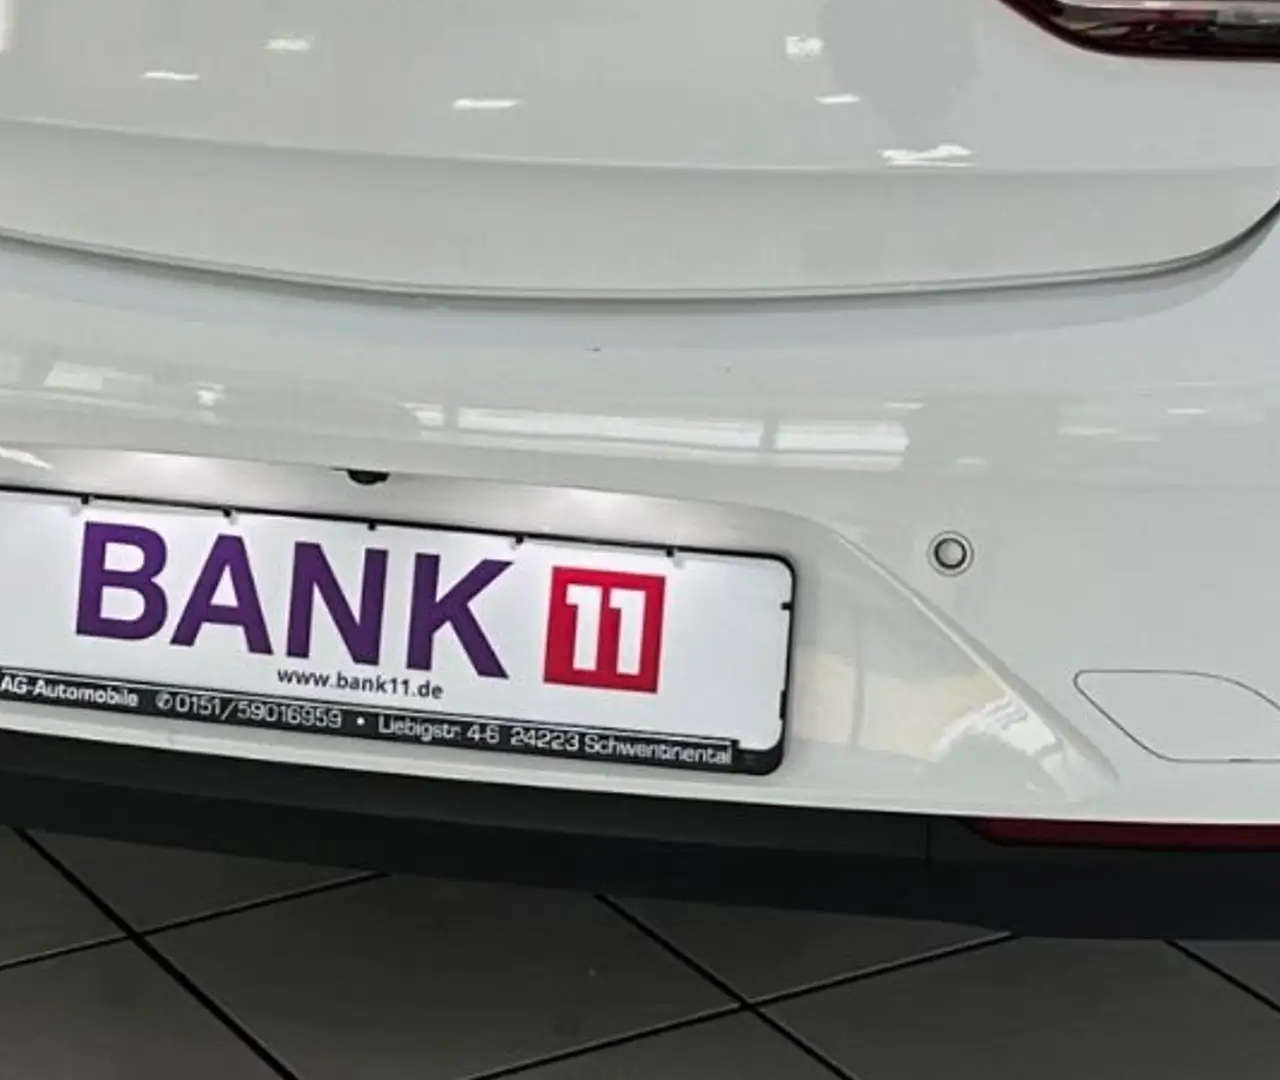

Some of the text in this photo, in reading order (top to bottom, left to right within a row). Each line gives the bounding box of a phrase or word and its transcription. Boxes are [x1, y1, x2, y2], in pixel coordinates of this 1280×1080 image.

[76, 520, 648, 680] BANK 11
[0, 674, 140, 708] AG-Automobile
[378, 714, 462, 743] Liebigstr.
[467, 720, 500, 744] 4-6
[510, 726, 580, 752] 24223
[584, 737, 734, 766] Schwentinental
[276, 665, 444, 701] www.bank11.de
